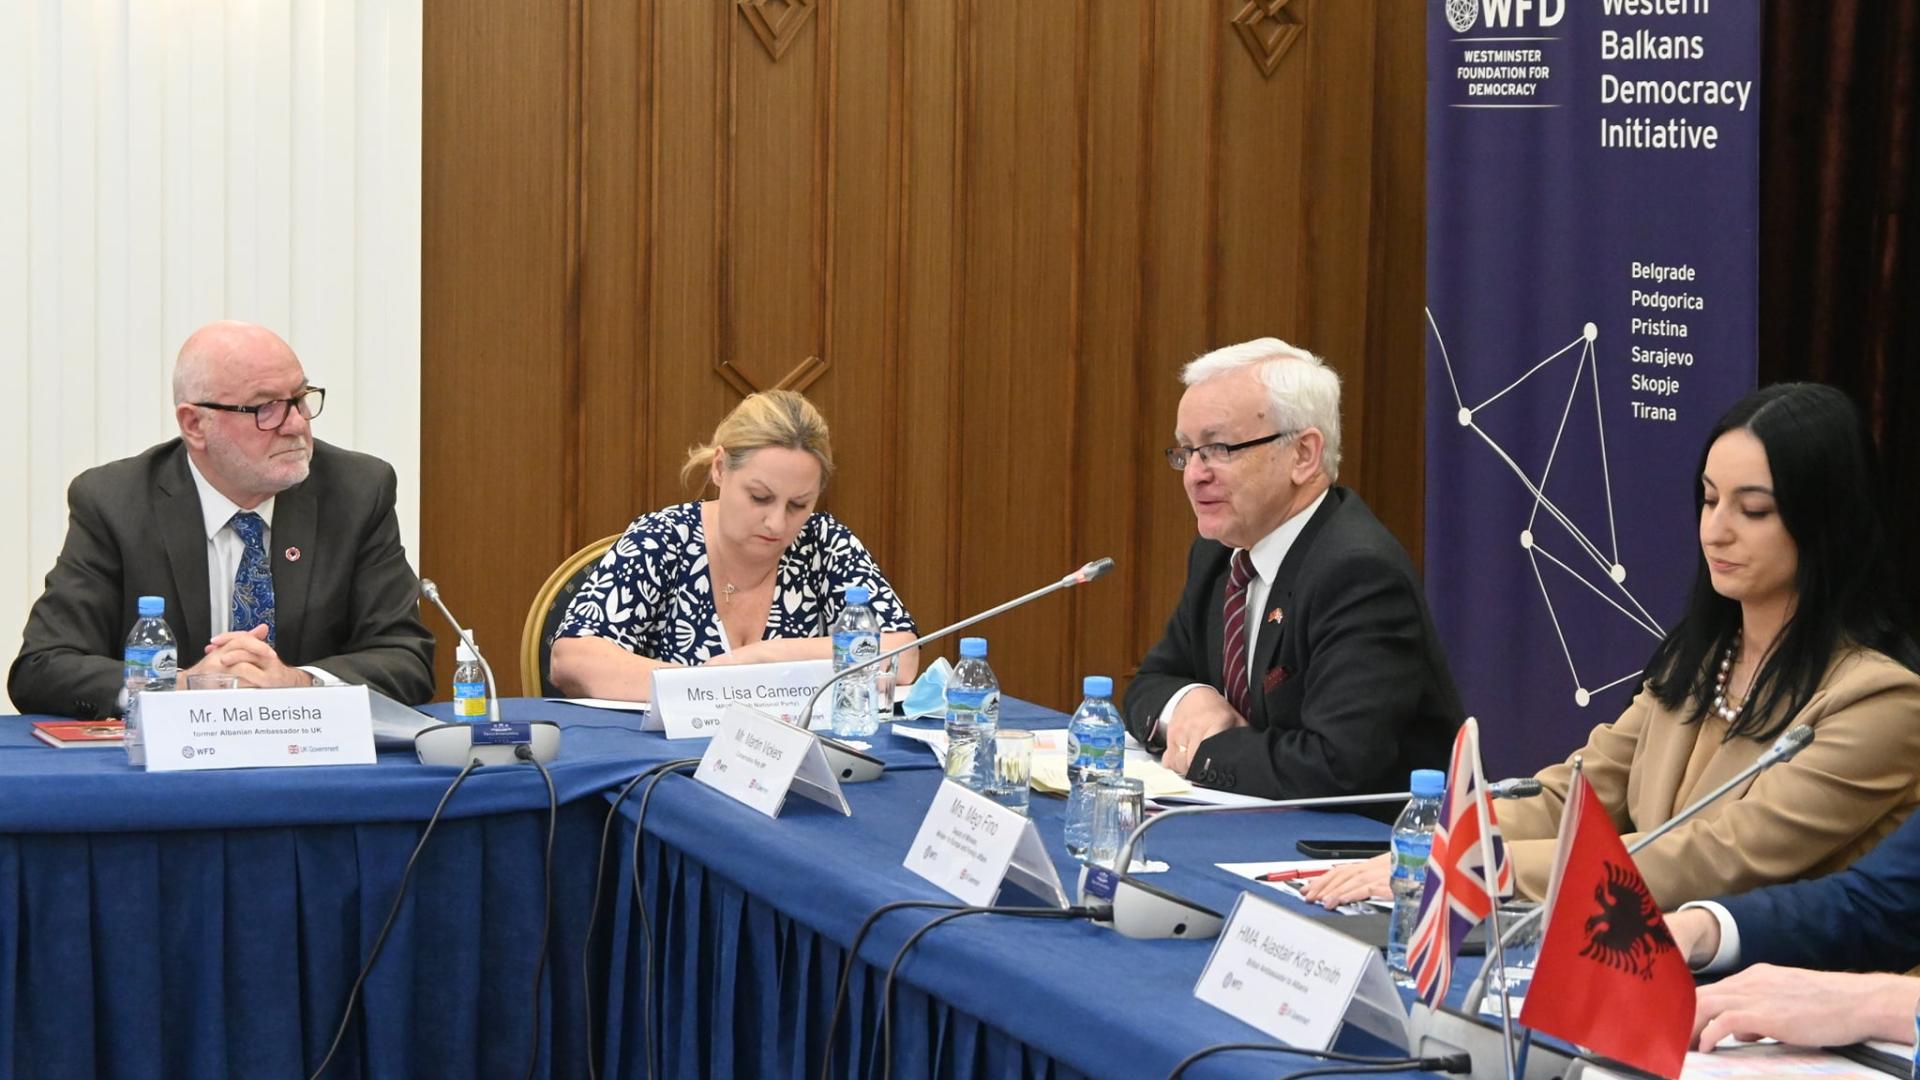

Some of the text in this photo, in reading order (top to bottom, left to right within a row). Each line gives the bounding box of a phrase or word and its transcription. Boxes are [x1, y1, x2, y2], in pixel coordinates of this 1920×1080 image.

[1482, 0, 1566, 28] WFD
[1601, 29, 1704, 60] Balkans
[1464, 50, 1541, 63] WESTMINSTER
[1457, 66, 1549, 79] FOUNDATION FOR
[1468, 83, 1537, 96] DEMOCRACY
[1601, 74, 1752, 111] Democracy
[1601, 118, 1718, 149] Initiative
[1631, 262, 1696, 283] Belgrade
[1631, 290, 1704, 311] Podgorica
[1631, 318, 1688, 337] Pristina
[1631, 346, 1694, 368] Sarajevo
[1631, 374, 1680, 396] Skopje
[1631, 402, 1677, 421] Tirana
[687, 687, 718, 702] Mrs.
[723, 686, 752, 700] Lisa
[189, 706, 322, 723] Mr. Mal Berisha
[197, 747, 216, 756] WFD
